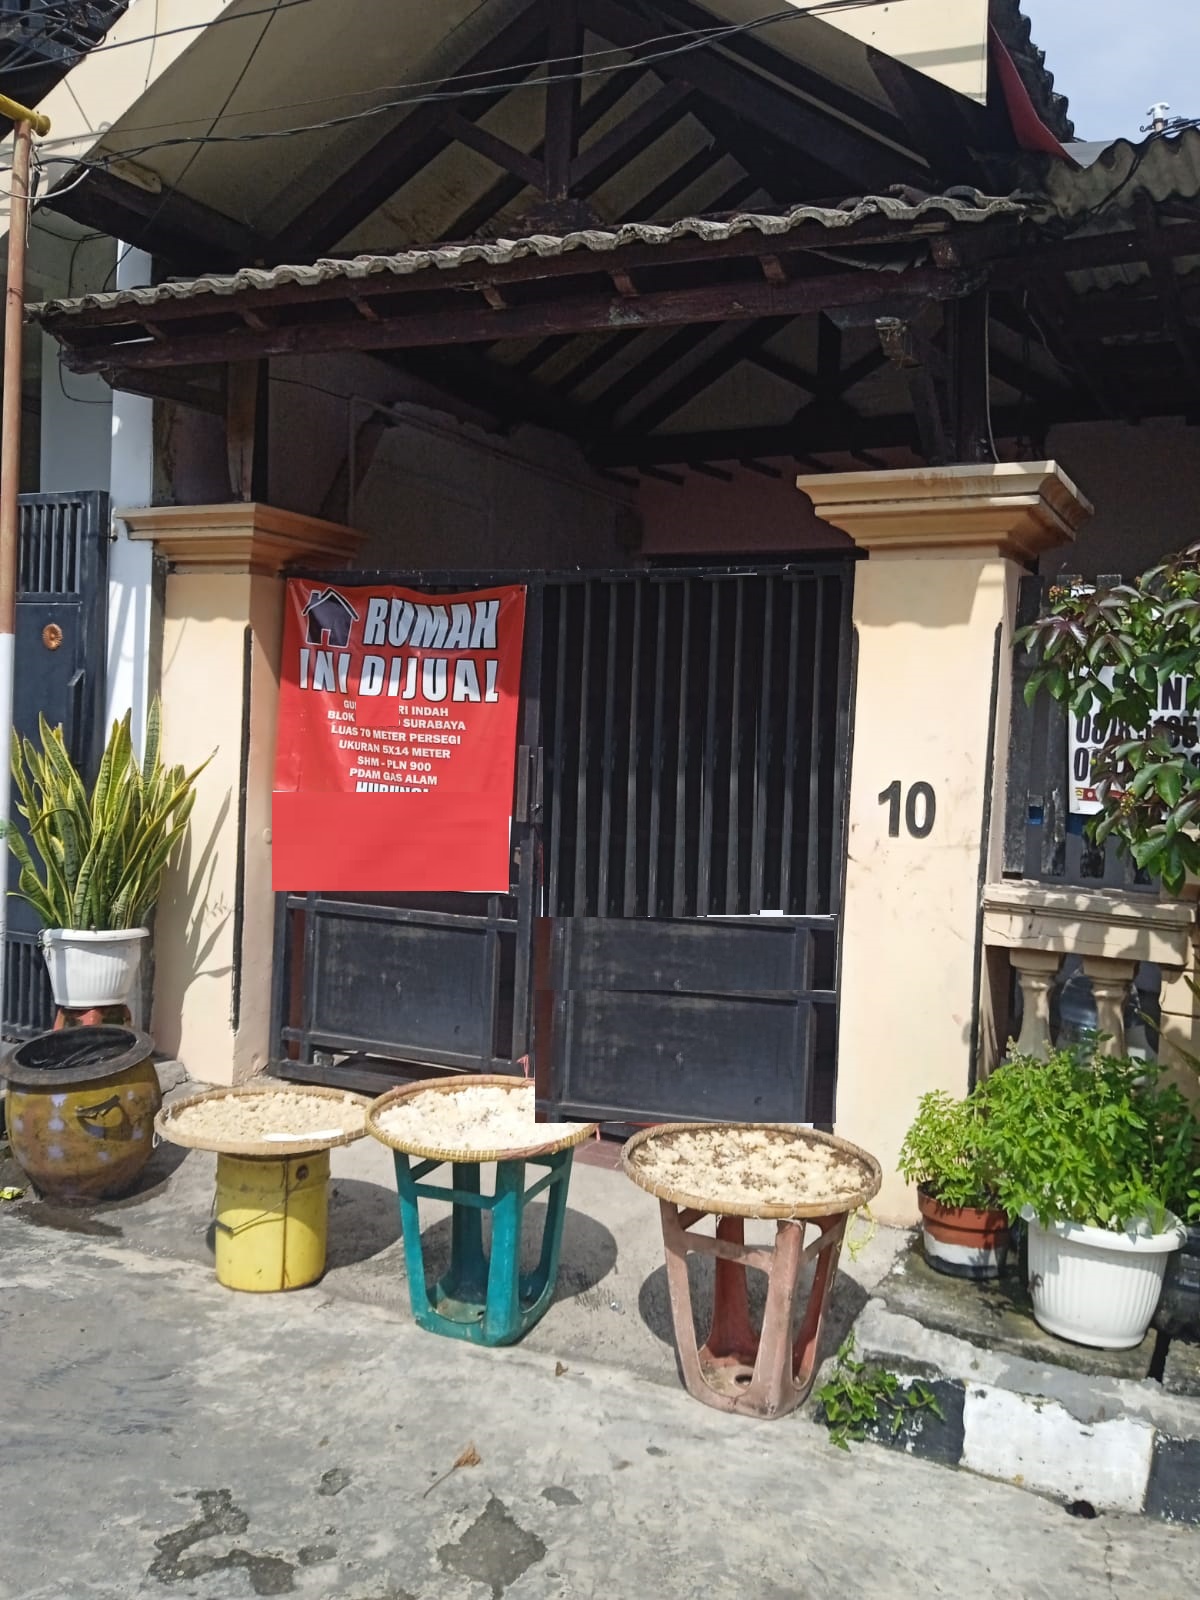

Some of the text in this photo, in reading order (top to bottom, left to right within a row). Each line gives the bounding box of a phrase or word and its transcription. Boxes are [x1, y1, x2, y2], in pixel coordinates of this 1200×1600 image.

[363, 598, 500, 649] RUMAH
[300, 648, 499, 703] INI DIJUAL
[327, 711, 355, 722] BLOK
[403, 718, 466, 730] SURABAYA
[412, 706, 449, 717] INDAH
[331, 725, 461, 745] LUAS 70 METER PERSEGI
[339, 739, 451, 759] UKURAN 5X14 METER
[357, 756, 379, 767] SHM
[387, 759, 407, 770] PLN
[410, 762, 431, 772] 900
[349, 767, 437, 785] PDAM GAS ALAM
[878, 780, 936, 839] 10
